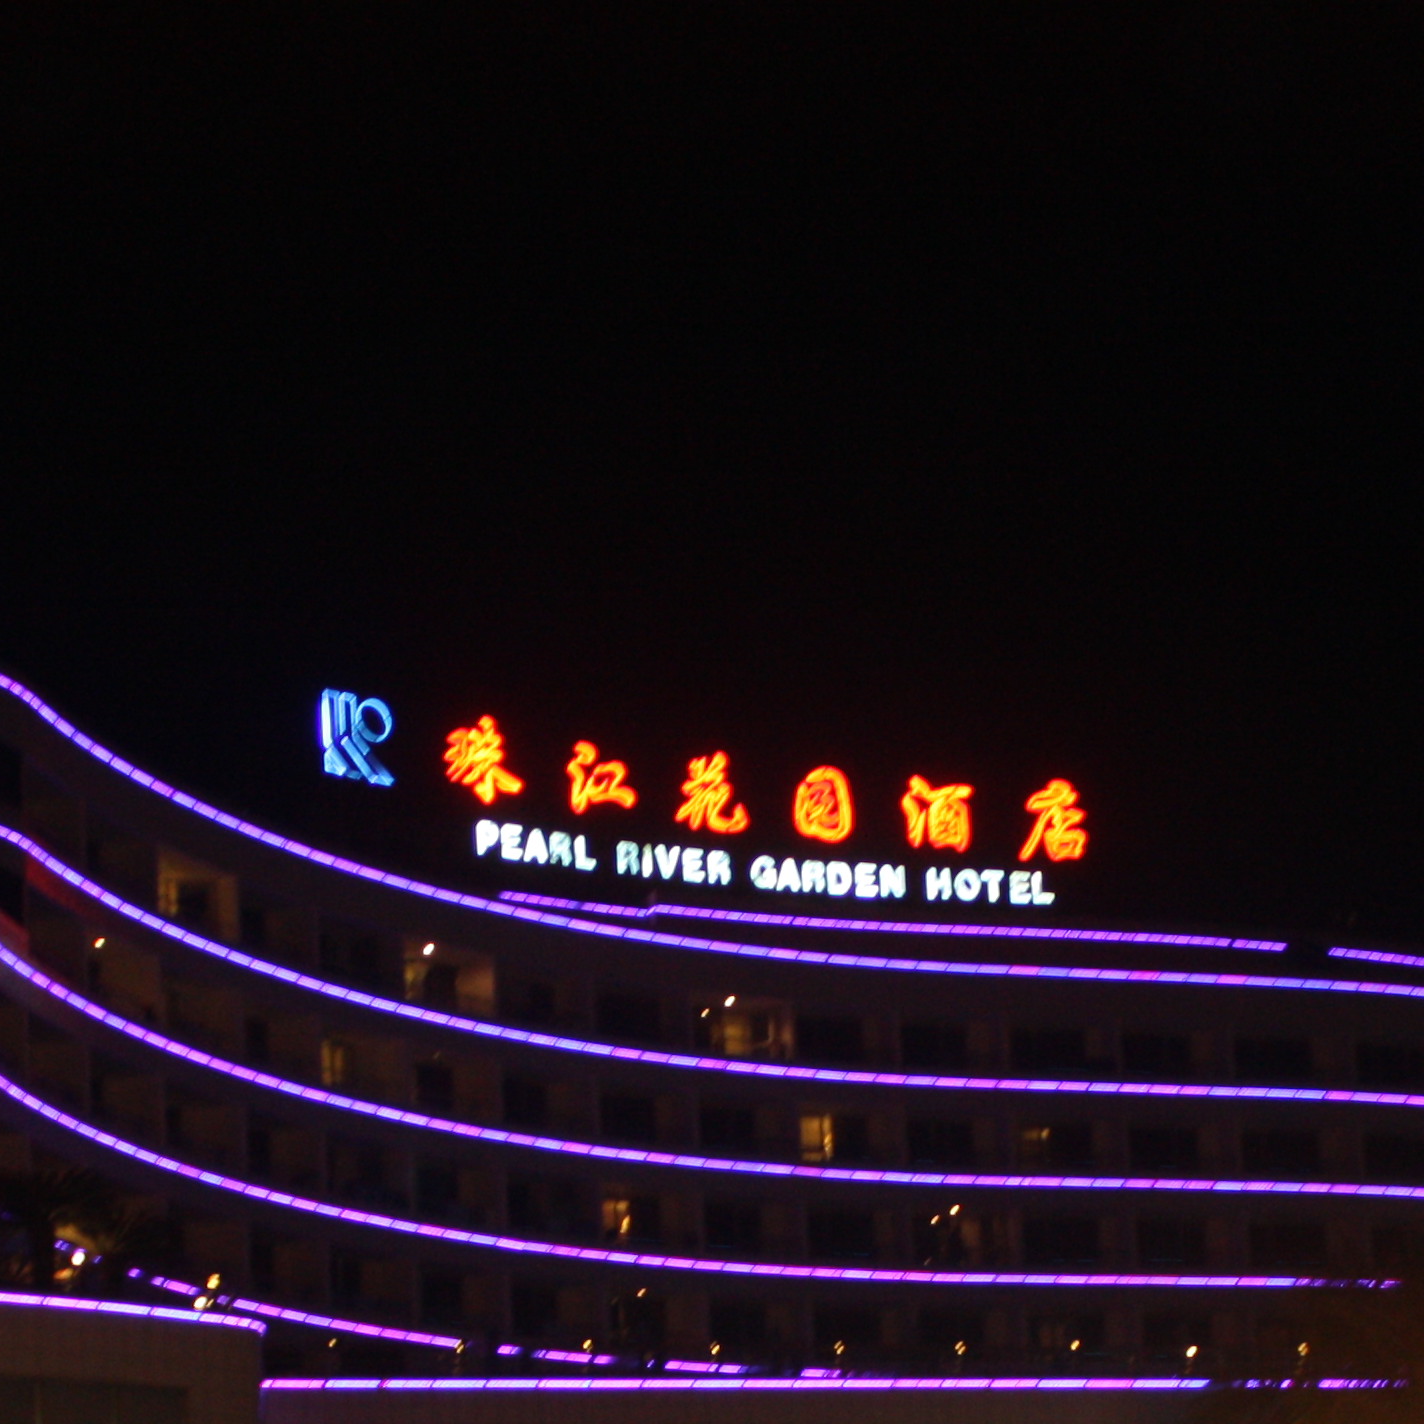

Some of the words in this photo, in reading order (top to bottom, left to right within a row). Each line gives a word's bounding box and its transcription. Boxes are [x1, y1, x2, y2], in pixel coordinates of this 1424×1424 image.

[441, 713, 1090, 863] 珠江花园酒店
[474, 818, 597, 872] PEARL
[615, 840, 732, 886] RIVER
[749, 854, 907, 899] GARDEN
[925, 866, 1056, 906] HOTEL
